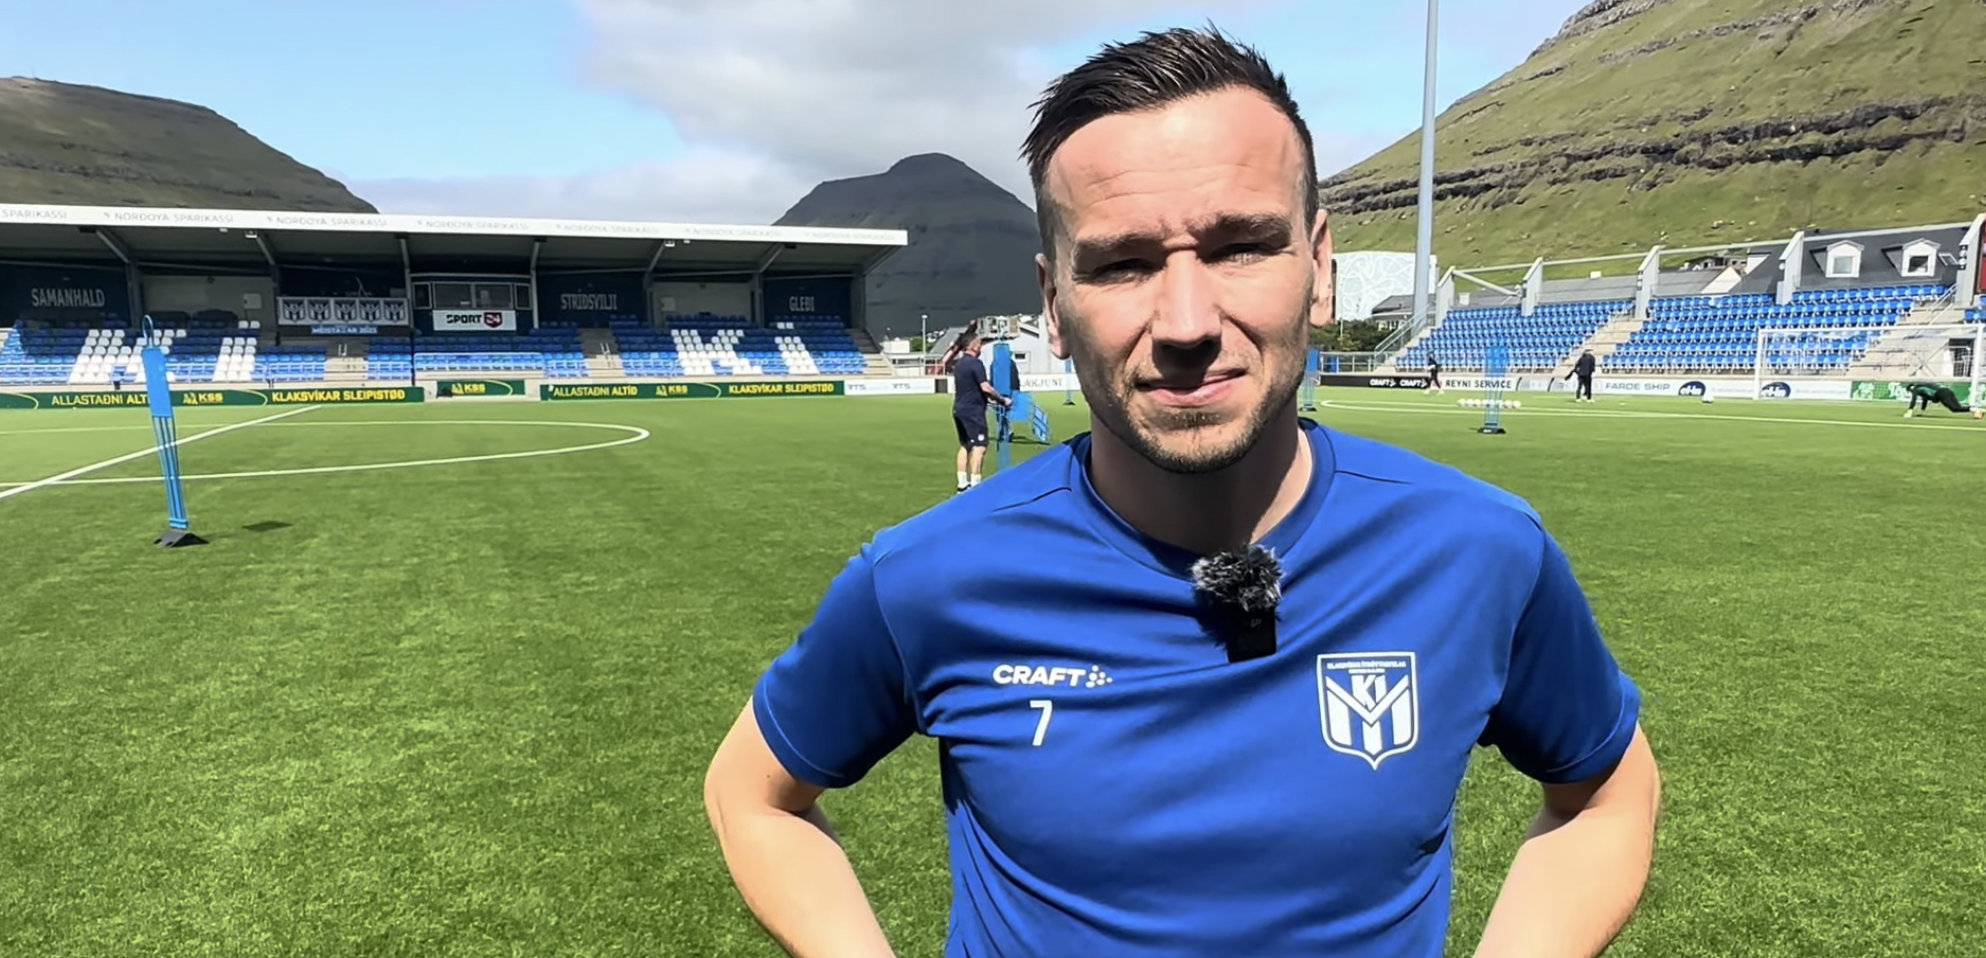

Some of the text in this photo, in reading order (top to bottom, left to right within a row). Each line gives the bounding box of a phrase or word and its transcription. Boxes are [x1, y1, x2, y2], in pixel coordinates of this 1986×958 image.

[31, 288, 105, 307] SAMANHALD
[446, 314, 482, 324] SPORT
[729, 383, 783, 394] KLAKSVÍKAR
[1020, 378, 1062, 388] AKJUNI
[1446, 380, 1471, 388] REYNI
[1644, 382, 1671, 391] SHIP
[126, 394, 150, 405] ALT
[199, 392, 223, 403] KSS
[272, 390, 341, 402] KLAKSVÍKAR
[993, 664, 1086, 687] CRAFT
[1030, 700, 1053, 746] 7
